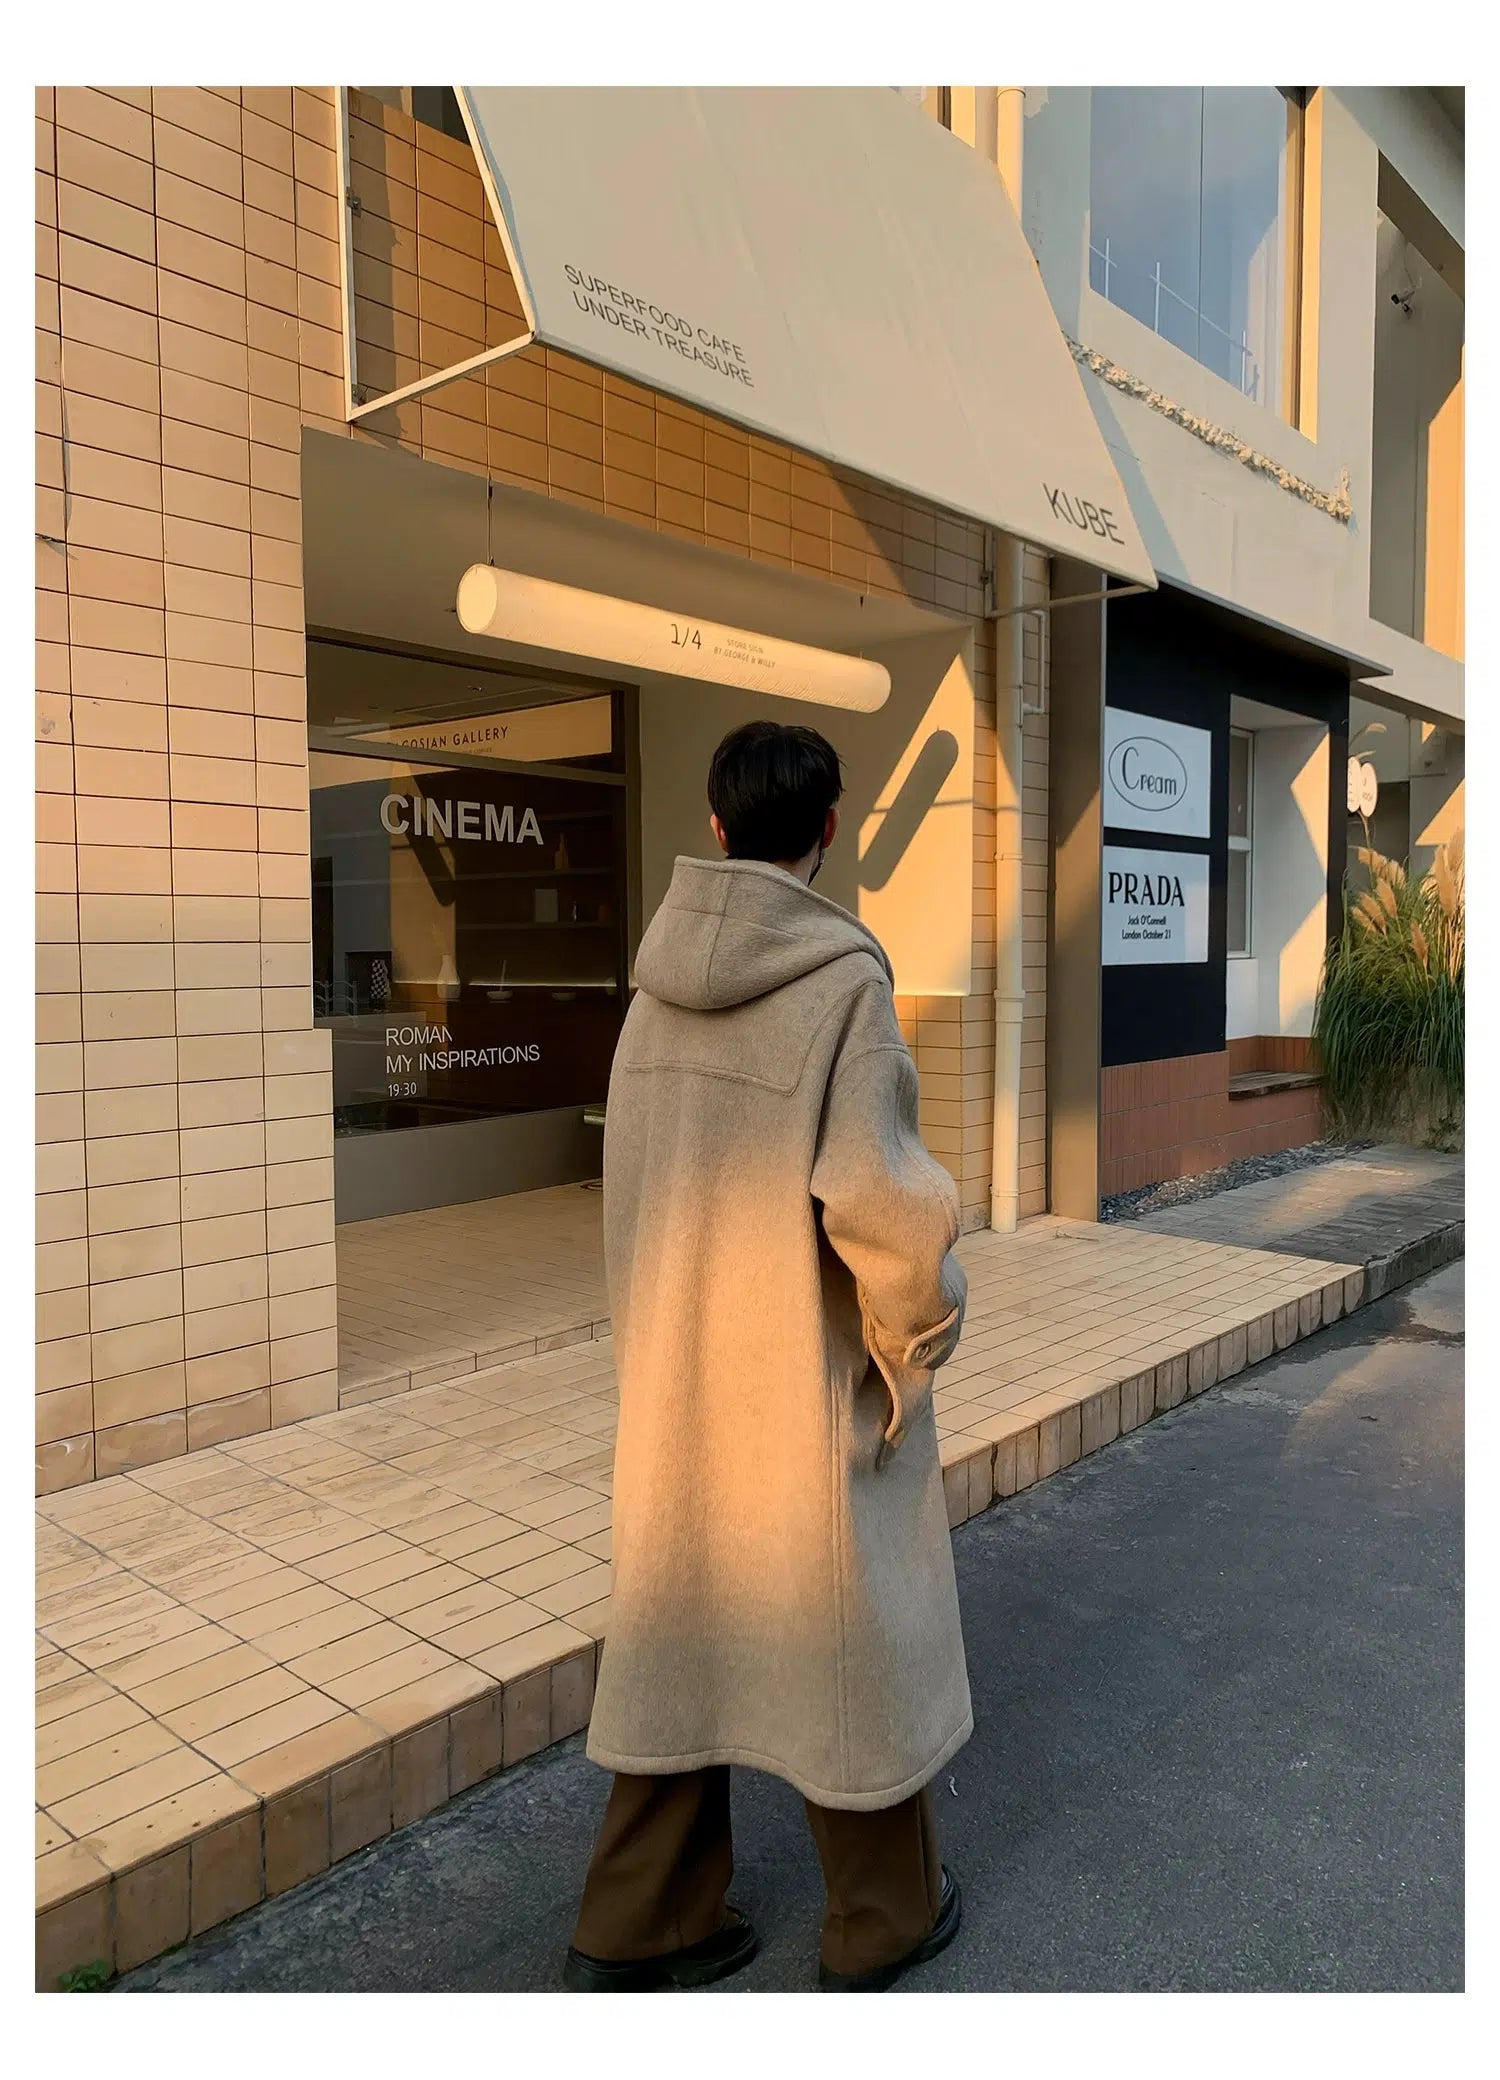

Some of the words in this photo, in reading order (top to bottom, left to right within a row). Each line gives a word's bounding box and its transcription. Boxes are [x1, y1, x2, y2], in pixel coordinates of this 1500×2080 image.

[564, 264, 693, 338] SUPERFOOD
[697, 328, 746, 364] CAFE
[572, 290, 650, 340] UNDER
[651, 327, 755, 388] TREASURE
[1043, 482, 1125, 546] KUBE
[671, 623, 702, 650] 1/4
[453, 726, 508, 746] GALLERY
[1122, 746, 1177, 796] Cream
[380, 793, 544, 846] CINEMA
[1108, 872, 1185, 907] PRADA
[1121, 929, 1141, 939] London
[1142, 929, 1163, 939] October
[1164, 929, 1171, 939] 21
[386, 1025, 453, 1047] ROMAN
[386, 1054, 413, 1074] MY
[419, 1044, 541, 1072] INSPIRATIONS
